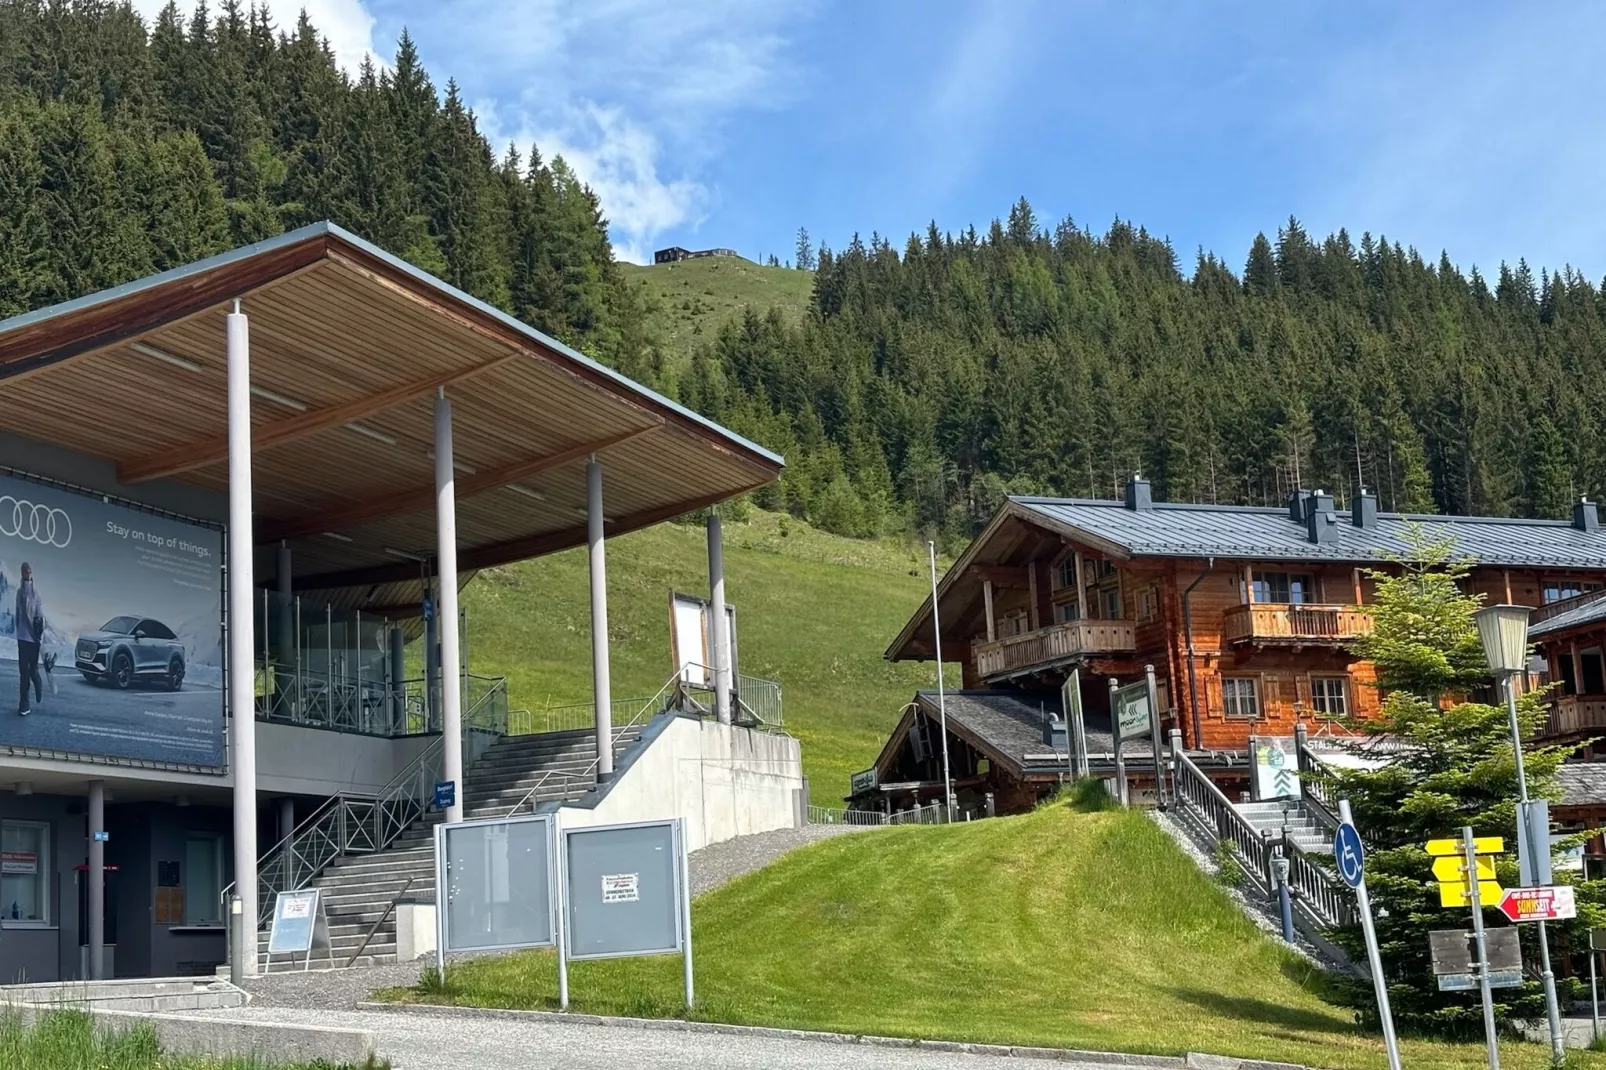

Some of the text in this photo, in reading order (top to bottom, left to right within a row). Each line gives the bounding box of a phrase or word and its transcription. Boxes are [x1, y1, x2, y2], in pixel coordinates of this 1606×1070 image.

[106, 521, 129, 539] Stay
[131, 530, 145, 541] on
[147, 532, 164, 547] top
[166, 538, 177, 549] of
[179, 541, 212, 557] things.
